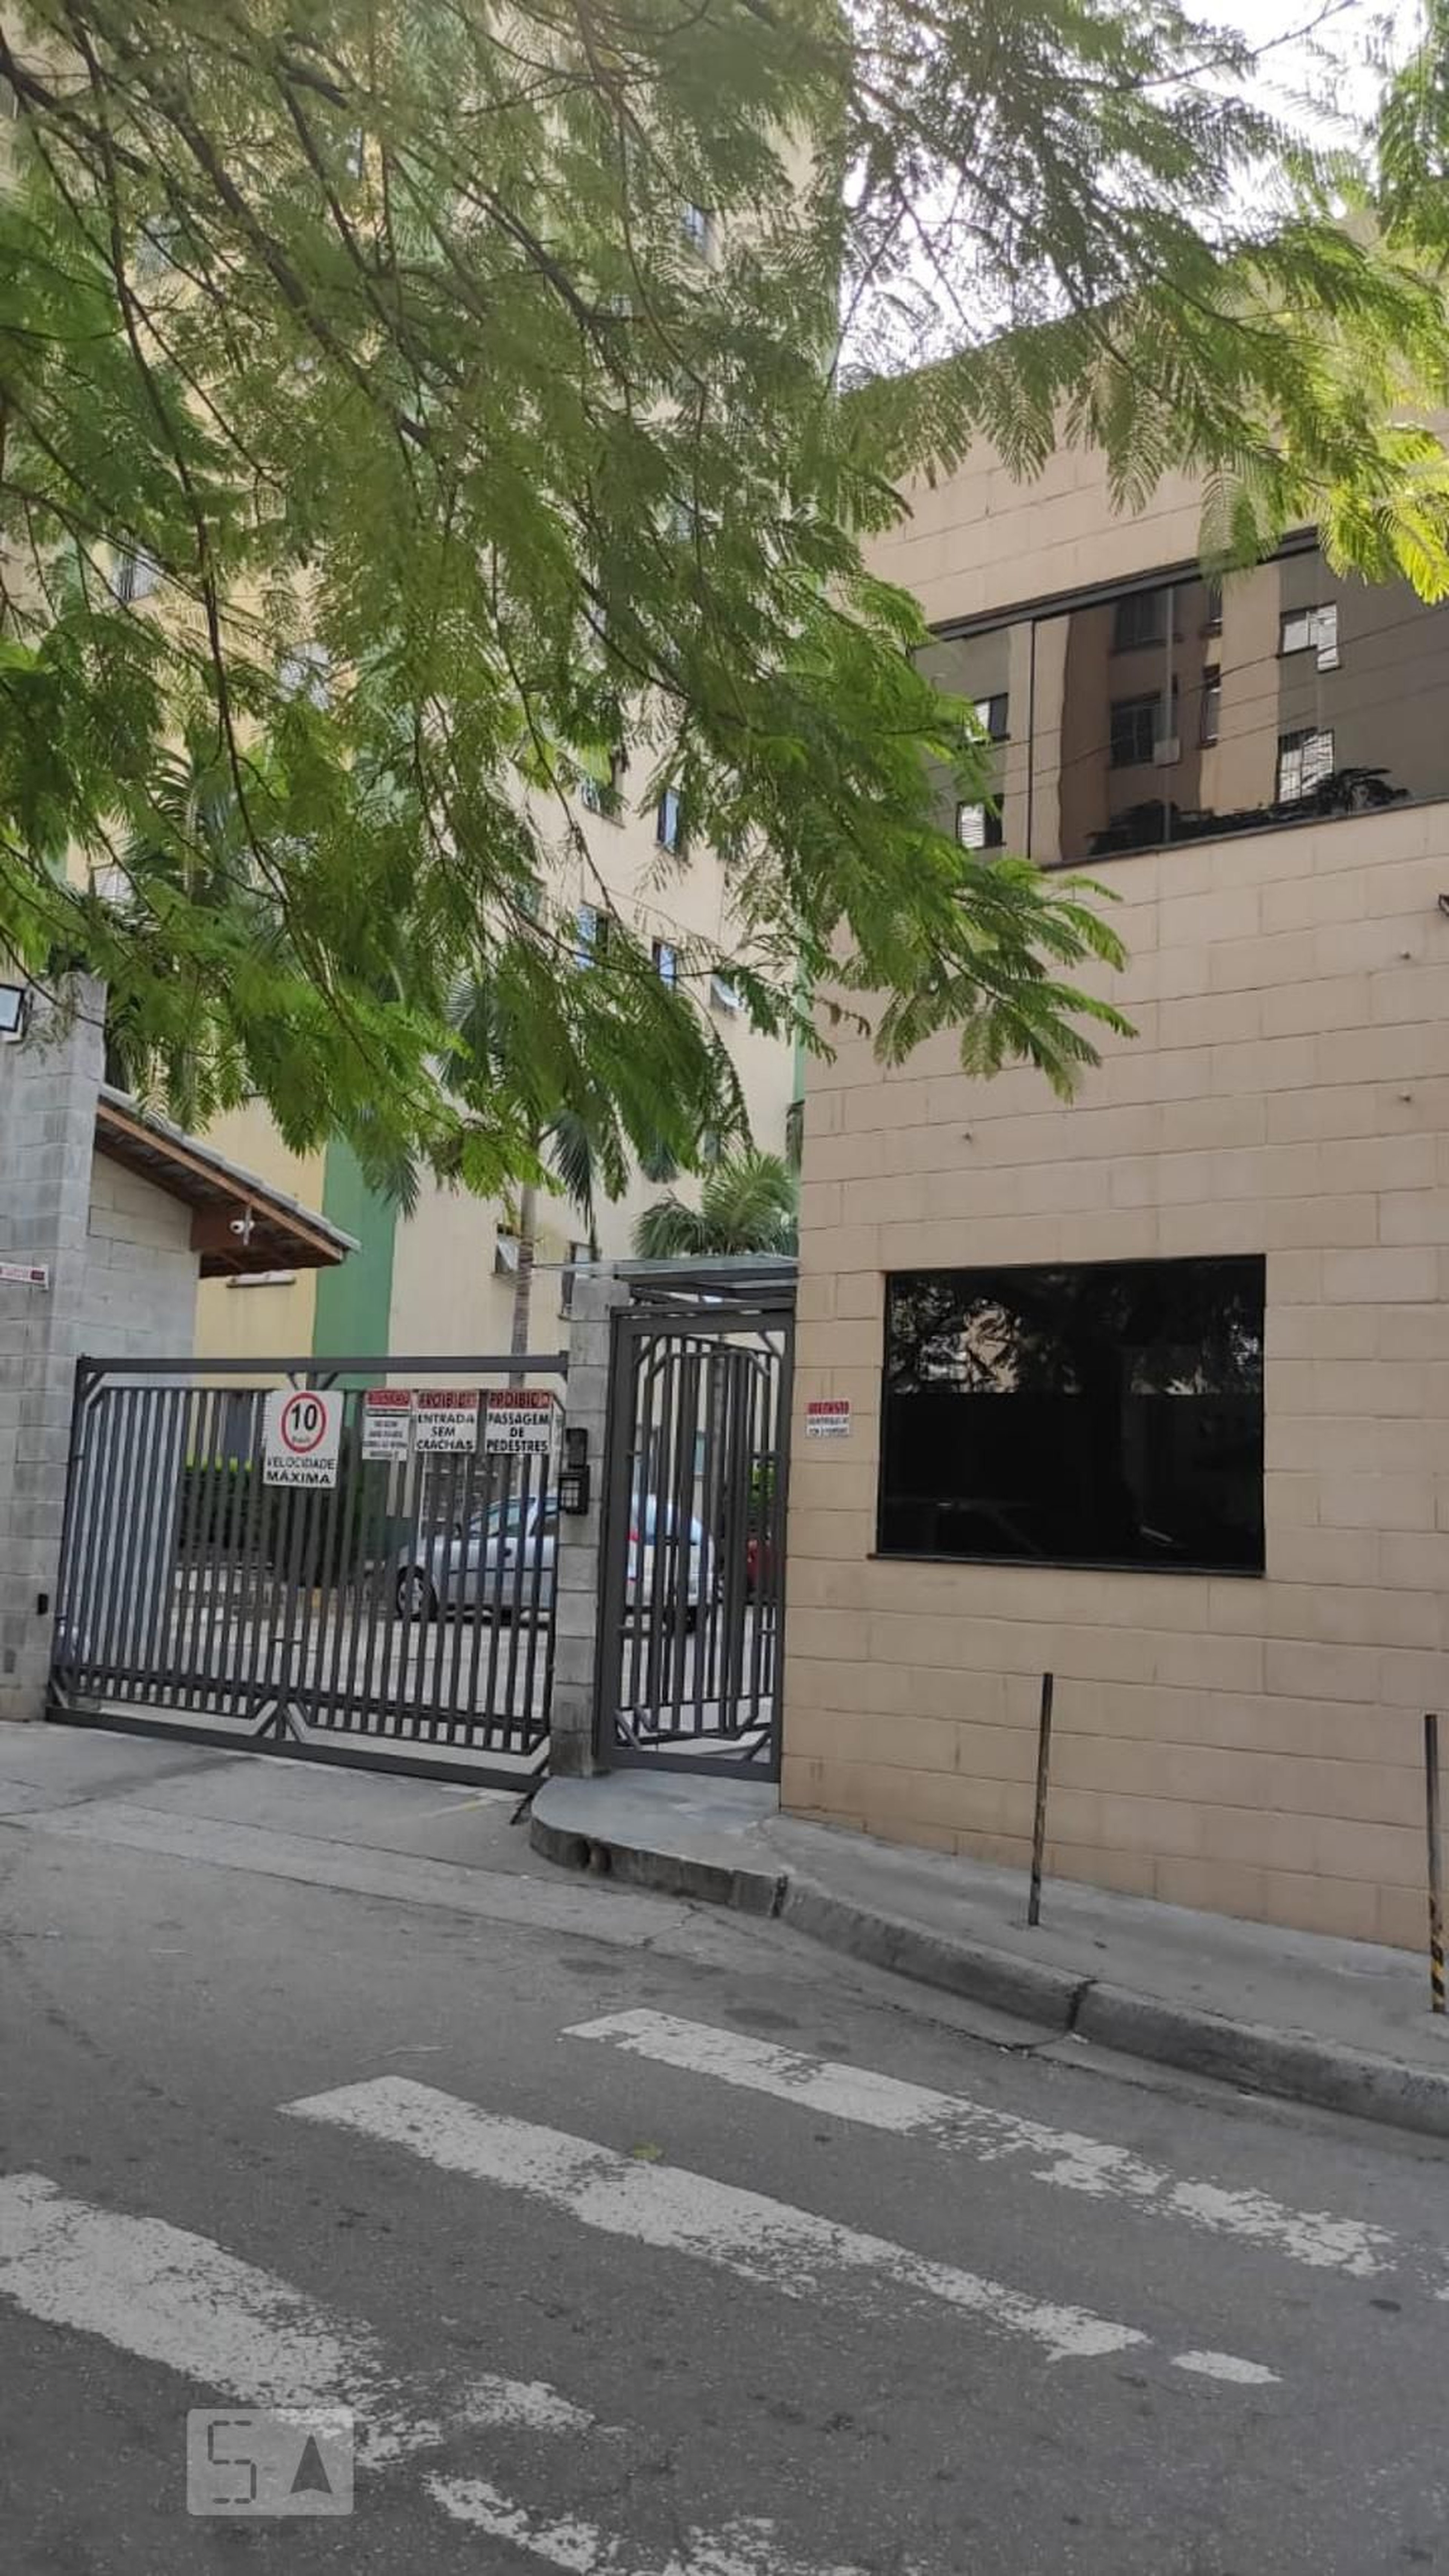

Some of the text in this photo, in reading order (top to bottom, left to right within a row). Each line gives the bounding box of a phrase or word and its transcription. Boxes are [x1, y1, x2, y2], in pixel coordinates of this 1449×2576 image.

[291, 1403, 318, 1430] 10
[417, 1414, 474, 1423] ENTRADA
[488, 1413, 548, 1425] PASSAGEM
[432, 1426, 455, 1437] SEM
[510, 1427, 524, 1437] DE
[487, 1439, 548, 1451] PEDESTRES
[267, 1456, 337, 1470] VELOCIDADE
